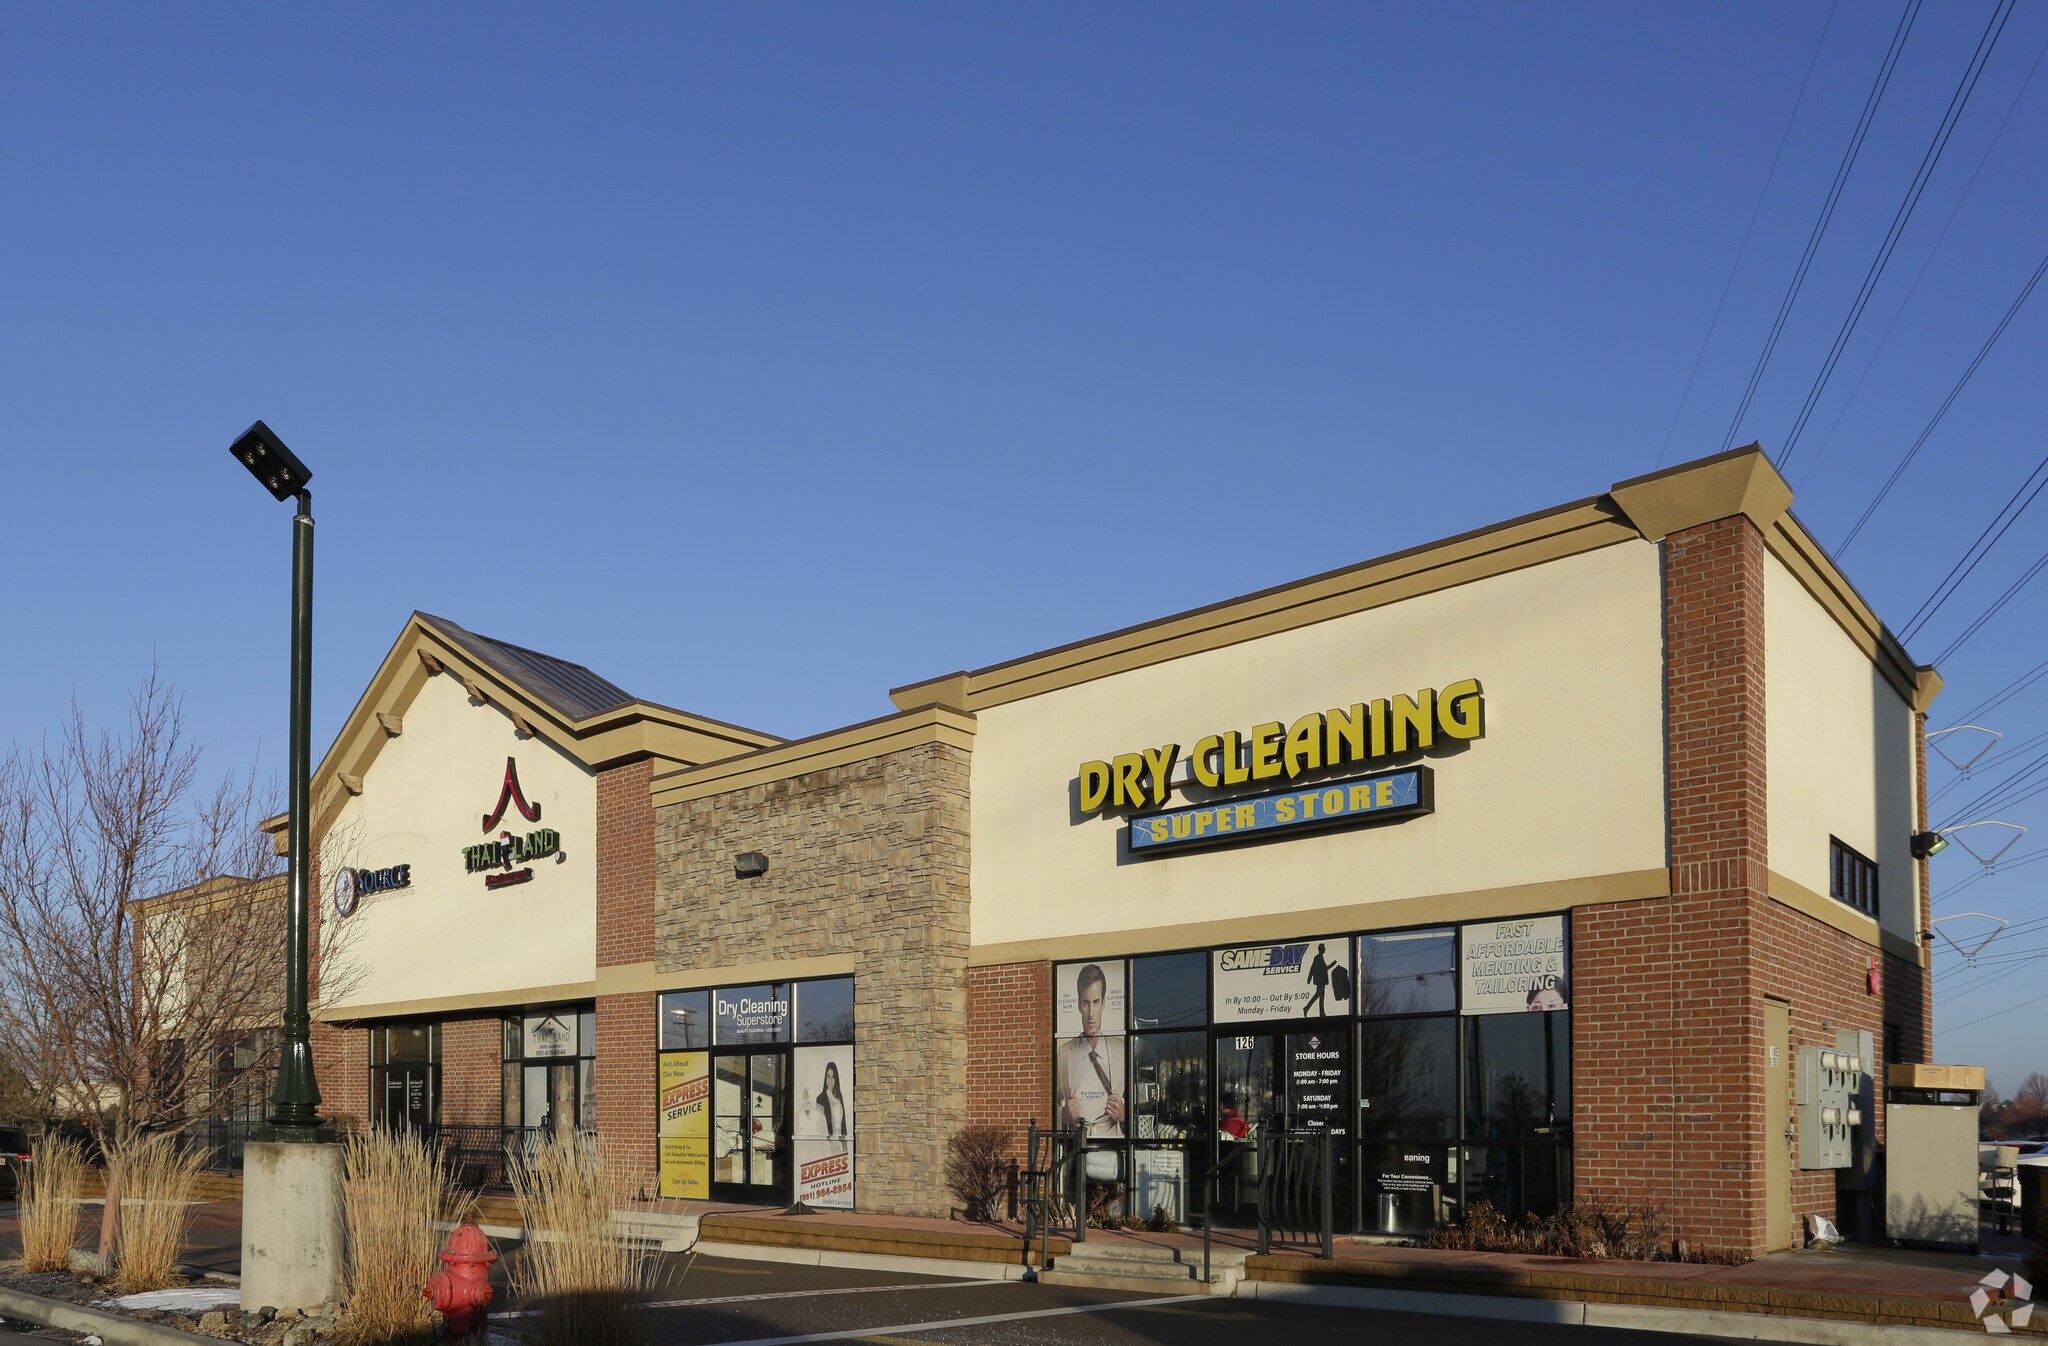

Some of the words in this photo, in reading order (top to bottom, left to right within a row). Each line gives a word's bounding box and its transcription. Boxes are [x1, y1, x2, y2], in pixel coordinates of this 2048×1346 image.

[1079, 743, 1181, 812] DRY
[1192, 677, 1486, 788] CLEANING
[1150, 804, 1255, 842] SUPER
[1275, 780, 1394, 823] STORE
[462, 841, 500, 870] THAI
[513, 828, 557, 859] LAND
[357, 864, 409, 896] SOURCE
[1496, 921, 1534, 939] FAST
[1466, 937, 1564, 960] AFFORDABLE
[1265, 965, 1300, 975] SERVICE
[1472, 957, 1541, 977] MENDING
[1545, 956, 1557, 972] &
[1475, 975, 1556, 995] TAILORING
[718, 1000, 738, 1019] Dry
[740, 998, 788, 1016] Cleaning
[1233, 996, 1242, 1005] By
[1243, 995, 1261, 1003] 10:00
[1284, 993, 1293, 1003] By
[1294, 992, 1310, 1000] 5:00
[1237, 1006, 1265, 1015] Monday
[1270, 1005, 1292, 1014] Friday
[736, 1014, 783, 1028] Superstore
[1236, 1036, 1254, 1049] 126
[1316, 1051, 1340, 1060] HOURS
[662, 1079, 708, 1107] EXPRESS
[667, 1101, 702, 1121] SERVICE
[801, 1157, 848, 1180] EXPRESS
[672, 1178, 680, 1186] Sign
[681, 1178, 687, 1186] Up
[687, 1178, 699, 1186] Today
[810, 1177, 842, 1189] HOTLINE
